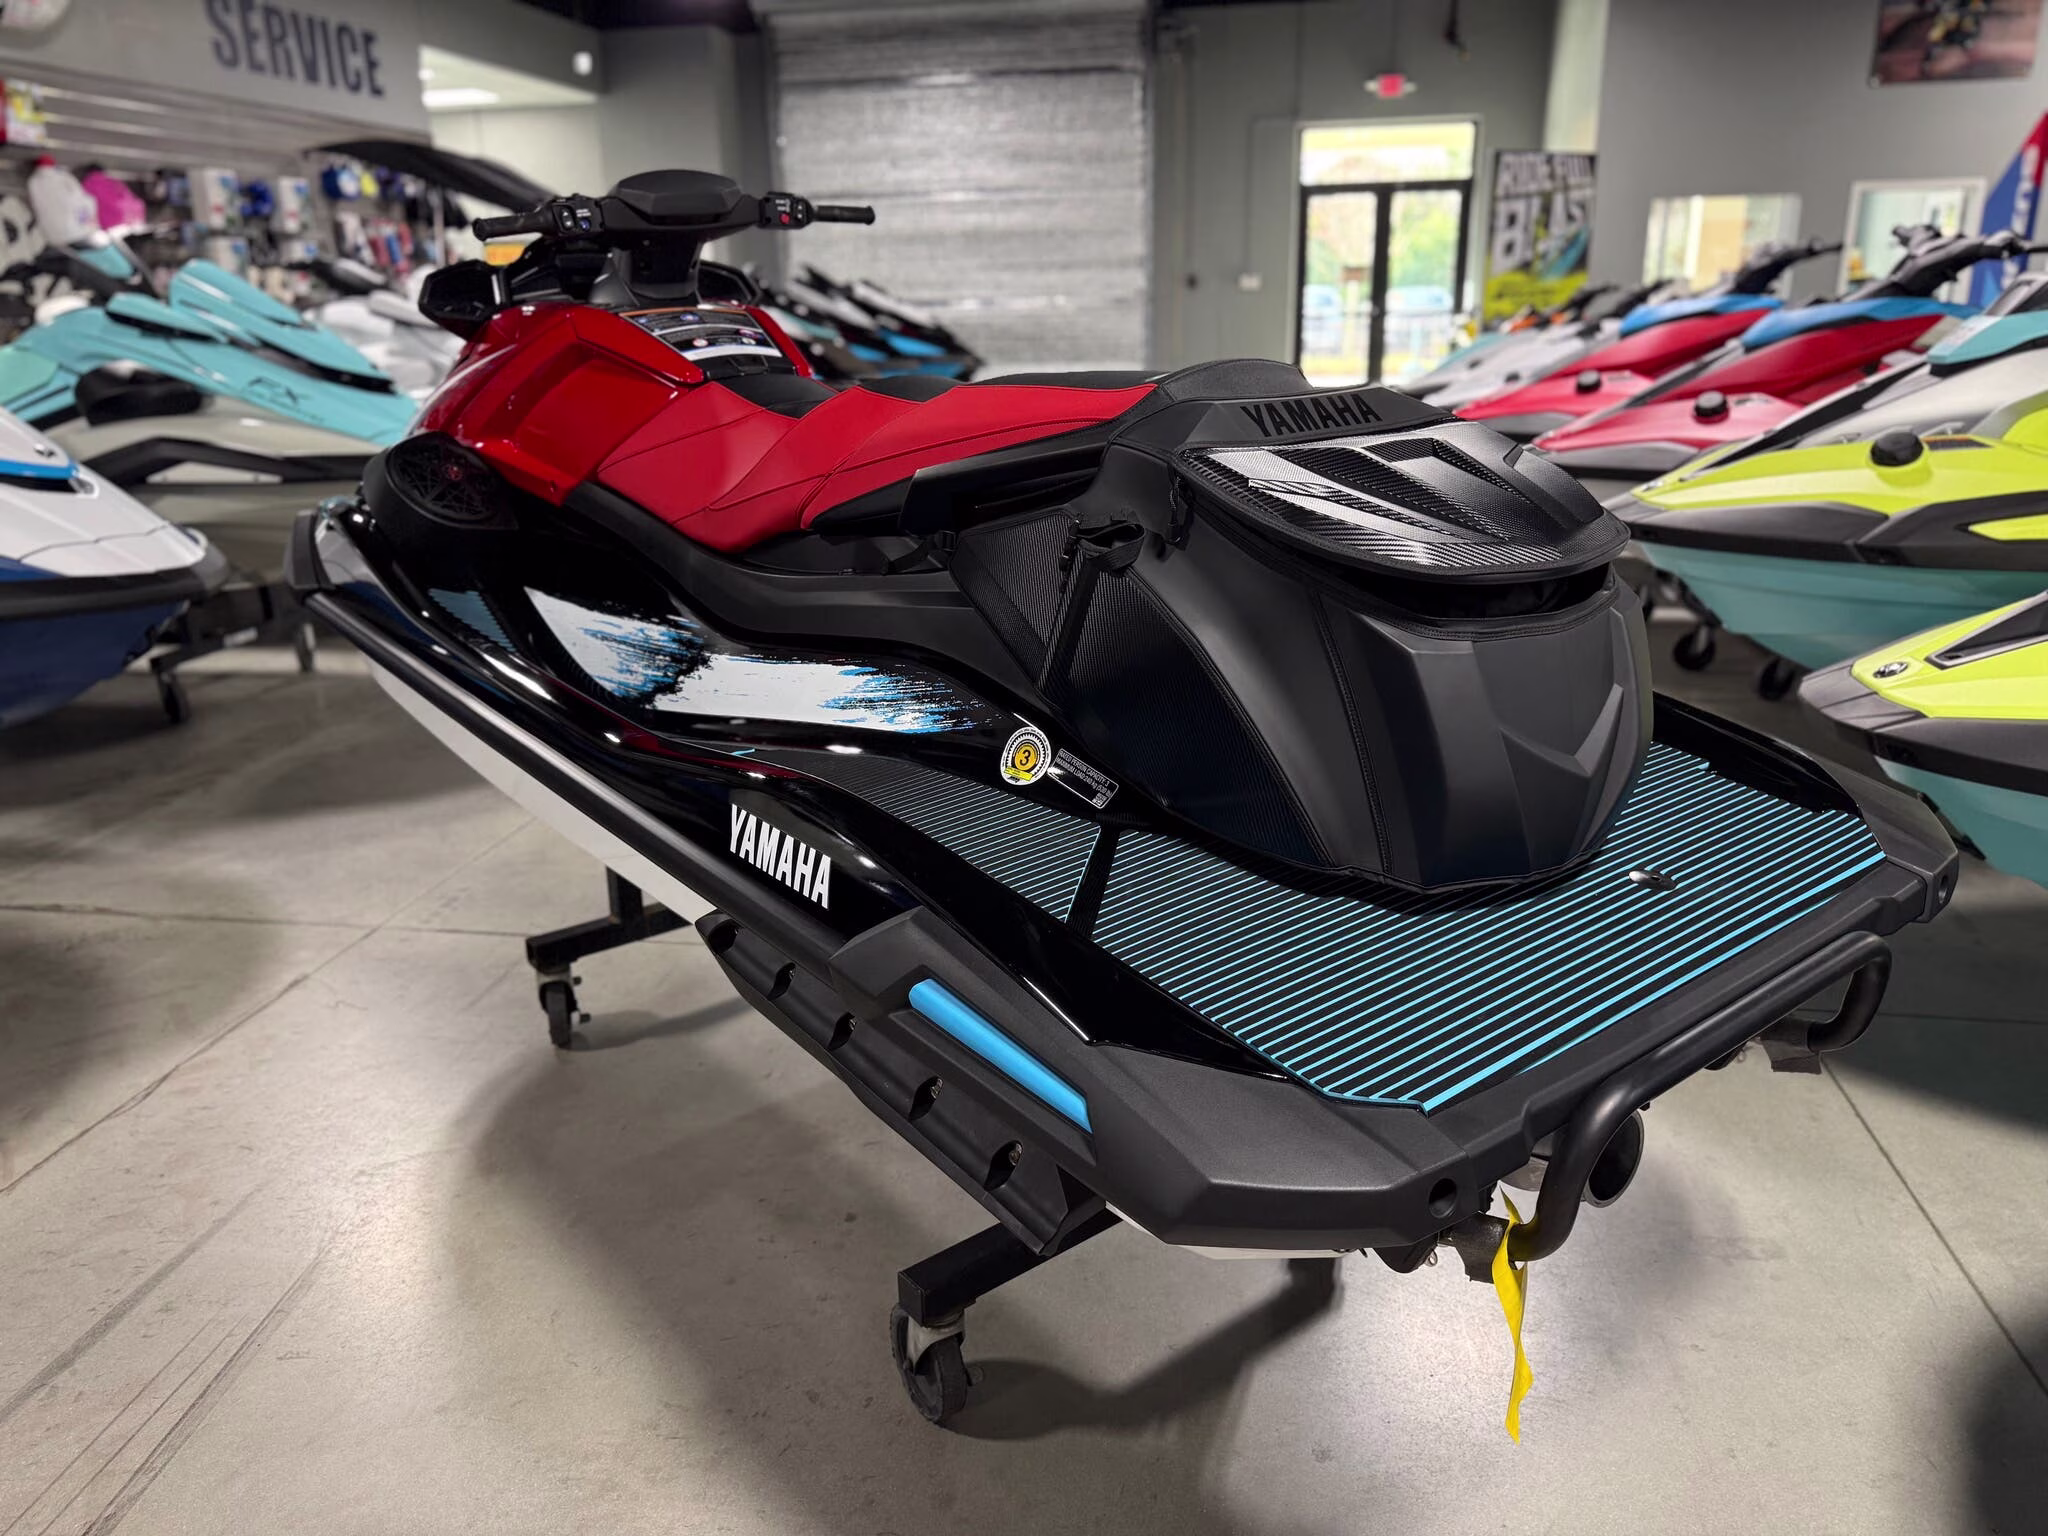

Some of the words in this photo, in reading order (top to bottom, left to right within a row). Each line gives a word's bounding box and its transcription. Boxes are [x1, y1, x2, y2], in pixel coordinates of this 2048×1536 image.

[206, 0, 386, 97] SERVICE
[1240, 394, 1383, 437] YAMAHA
[1020, 749, 1031, 766] 3
[1070, 758, 1088, 773] PERSON
[729, 803, 832, 910] YAMAHA
